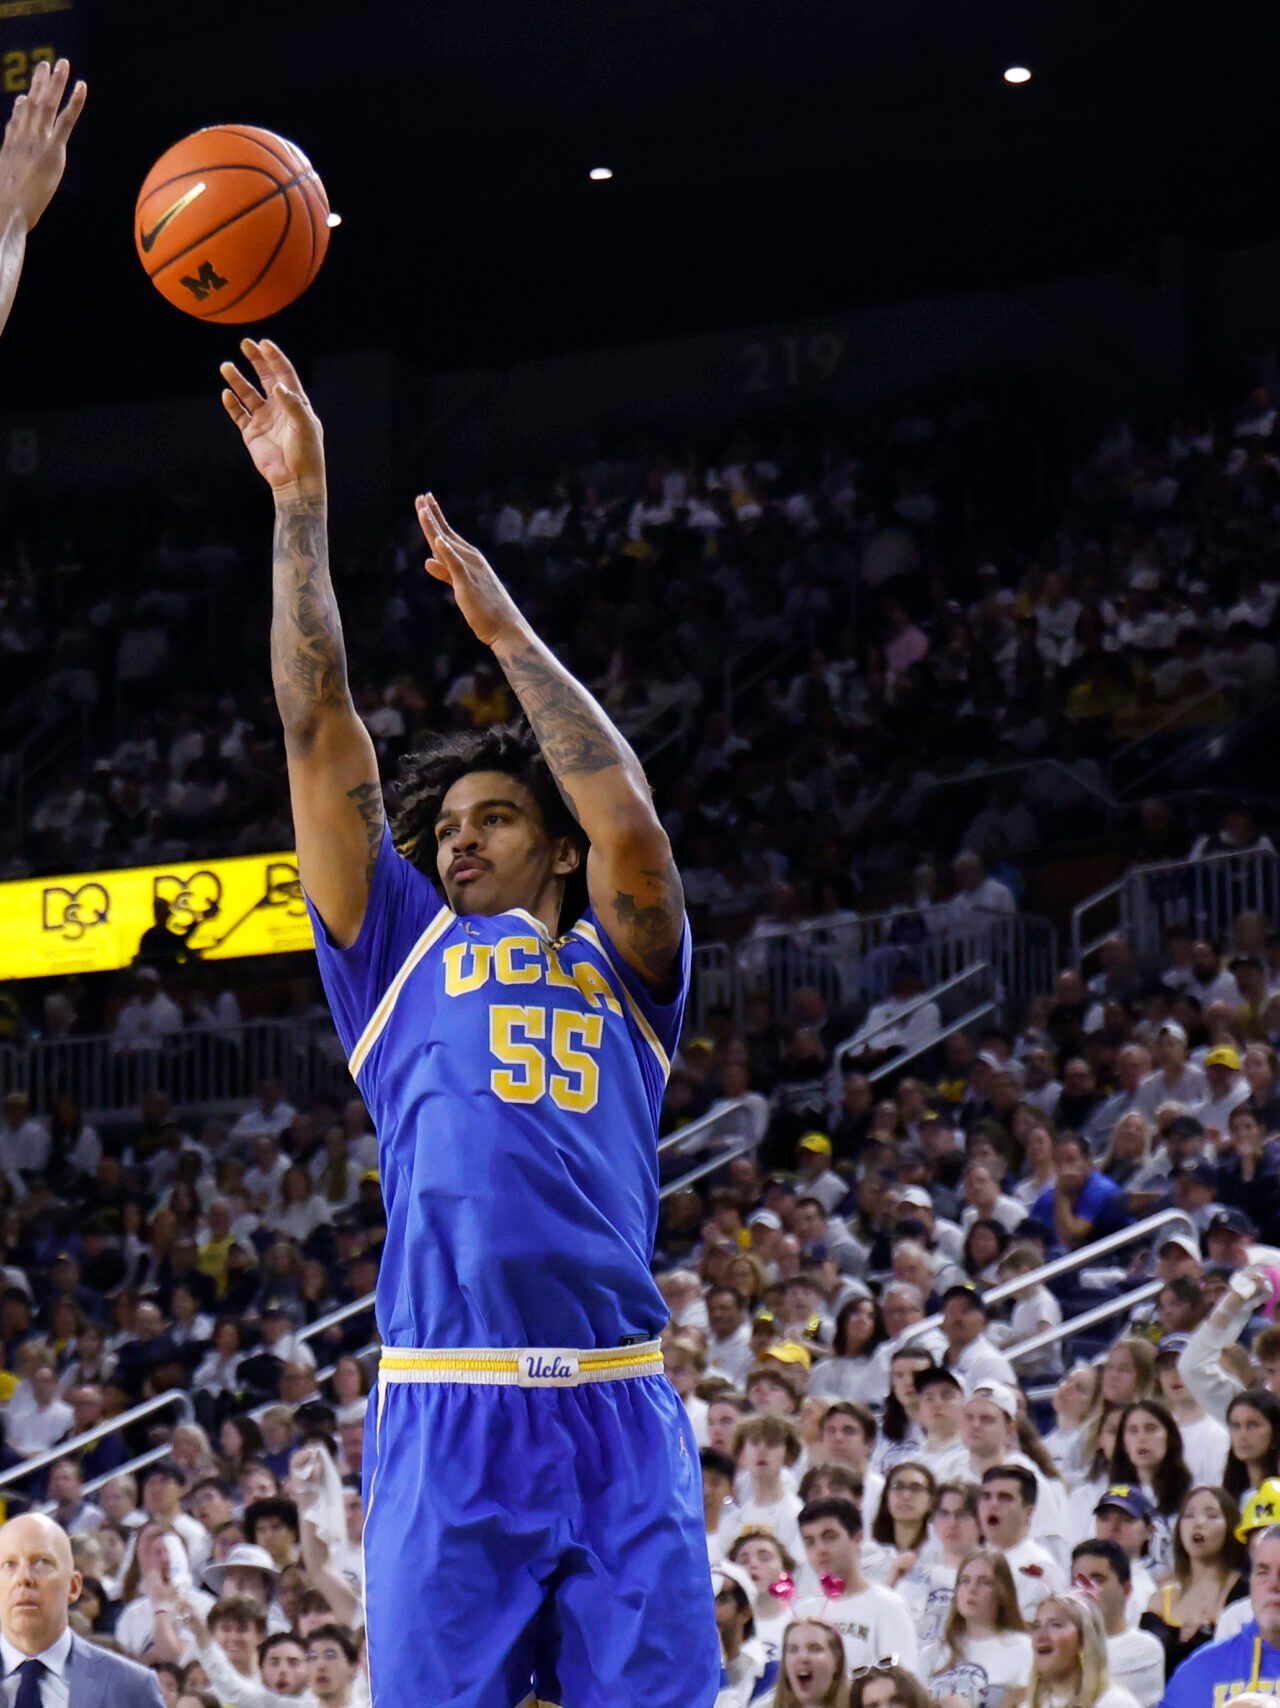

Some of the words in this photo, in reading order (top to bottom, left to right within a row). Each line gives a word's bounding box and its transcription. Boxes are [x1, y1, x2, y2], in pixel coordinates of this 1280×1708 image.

[179, 260, 228, 301] M
[443, 935, 624, 1018] UCLA
[488, 1004, 604, 1114] 55
[526, 1354, 573, 1380] Ucla
